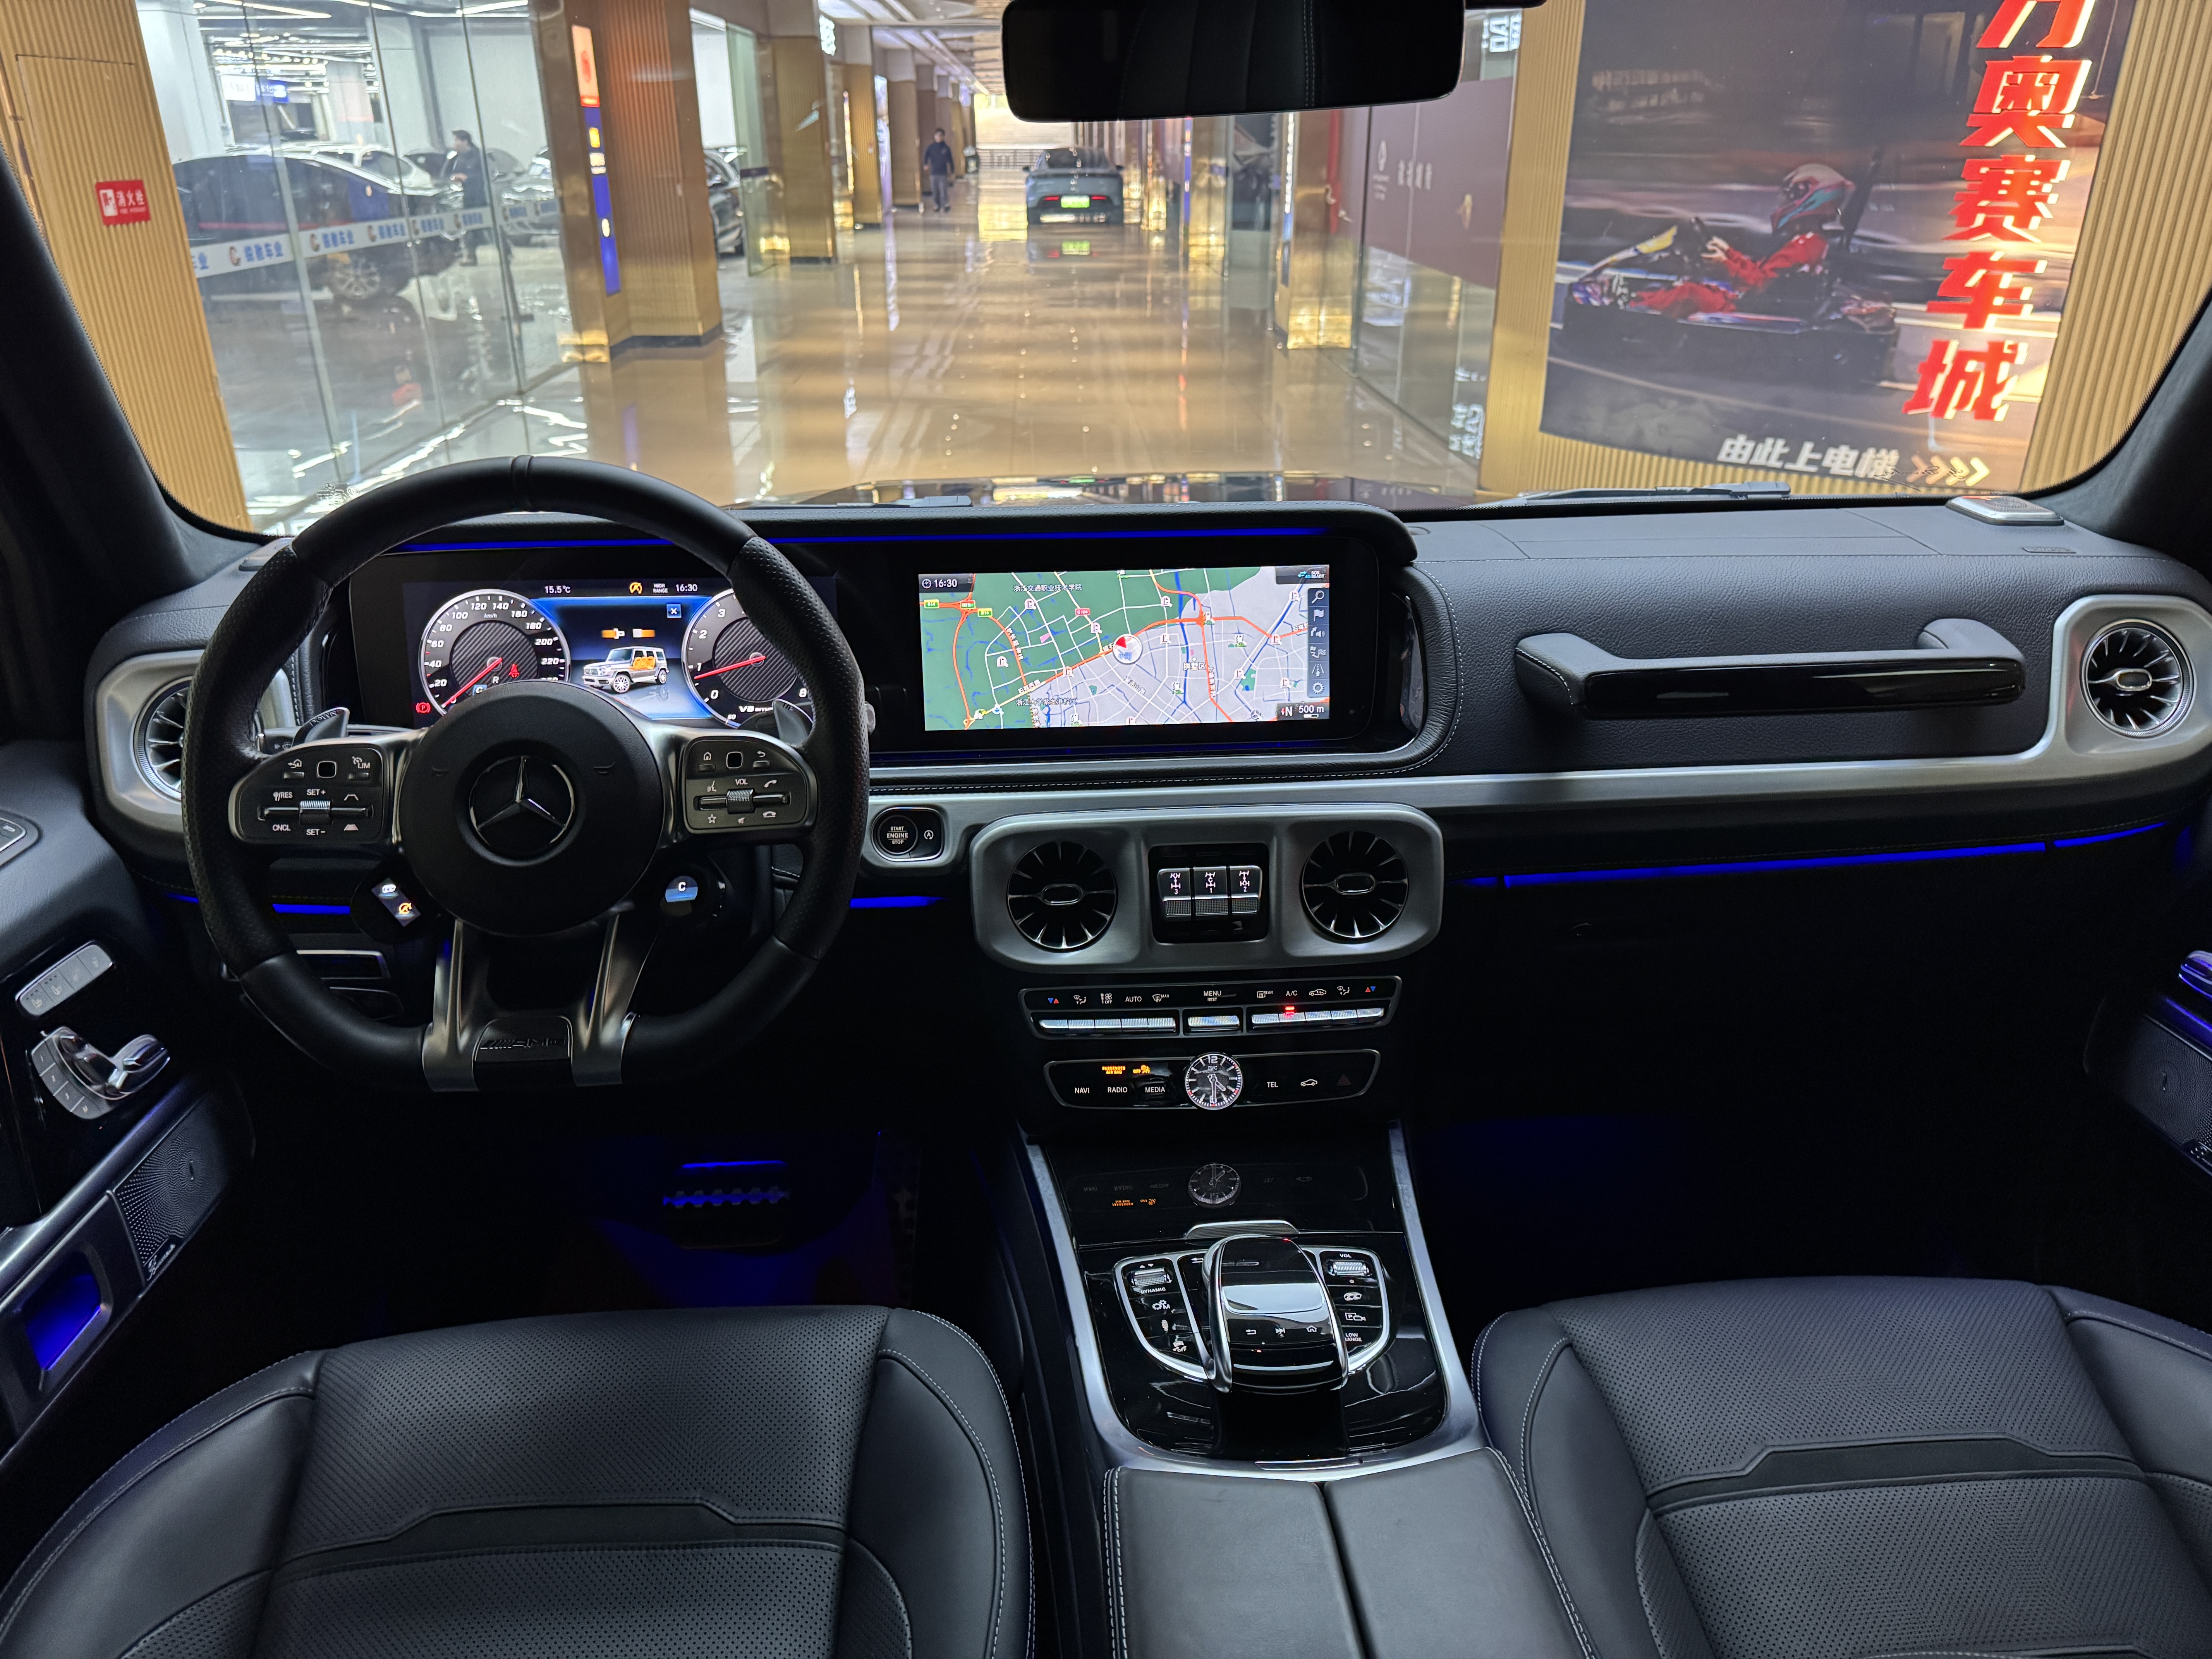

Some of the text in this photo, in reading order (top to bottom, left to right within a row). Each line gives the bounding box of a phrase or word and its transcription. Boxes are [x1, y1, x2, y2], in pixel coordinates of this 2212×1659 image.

[1717, 434, 1899, 480] 由此上电梯
[676, 584, 698, 592] 16:30
[934, 579, 958, 588] 16:30
[544, 585, 571, 594] 15.5°C
[718, 609, 726, 618] 3
[699, 630, 707, 639] 2
[697, 662, 702, 672] 1
[711, 690, 719, 699] 0
[799, 688, 807, 697] 8
[1285, 706, 1293, 716] N
[1298, 705, 1314, 713] 500
[678, 882, 686, 891] C
[1207, 1056, 1218, 1064] 12
